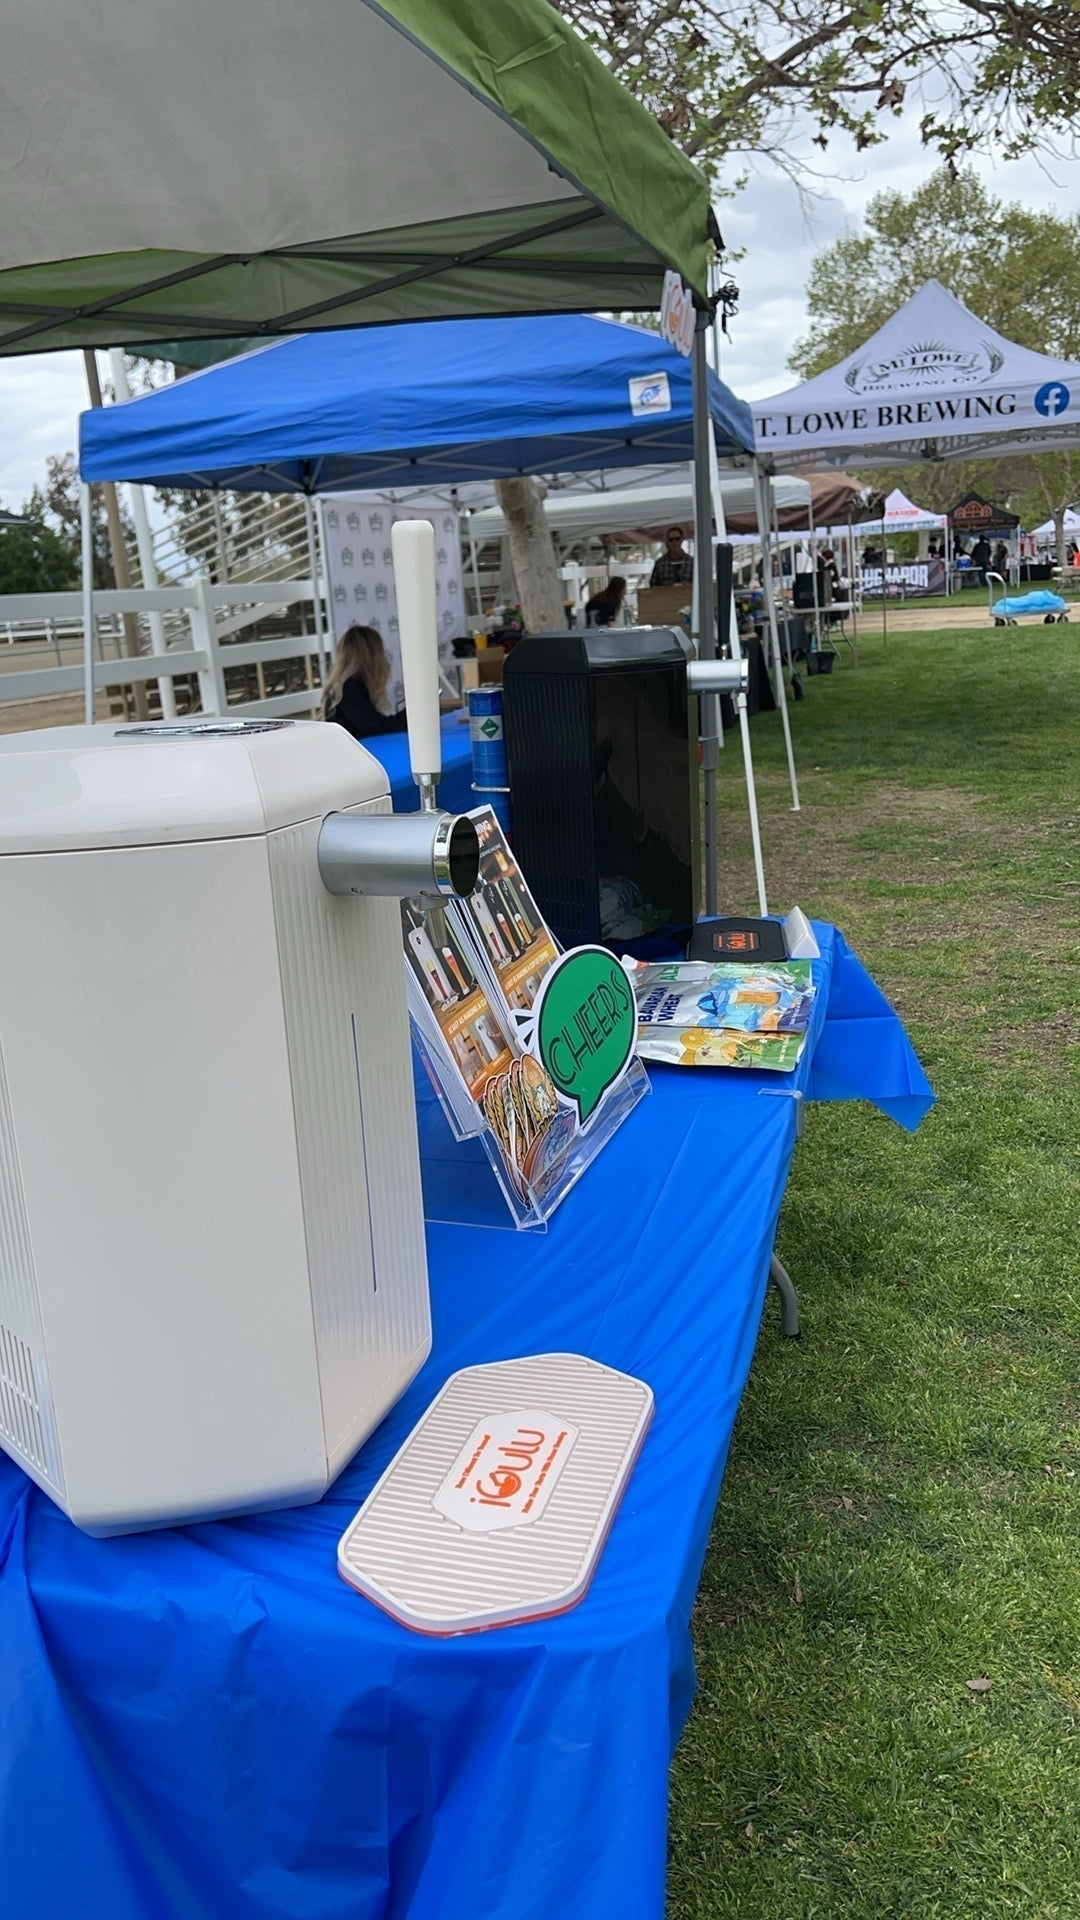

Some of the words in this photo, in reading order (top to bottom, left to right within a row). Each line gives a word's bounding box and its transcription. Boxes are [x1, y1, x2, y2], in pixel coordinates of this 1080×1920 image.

[911, 352, 966, 367] LOWE
[862, 379, 945, 392] BREWING
[756, 416, 777, 438] T.
[786, 409, 868, 435] LOWE
[878, 393, 1017, 427] BREWING
[657, 993, 684, 1022] WHEAT
[548, 968, 631, 1086] CHEERS
[469, 1428, 545, 1508] iGulu
